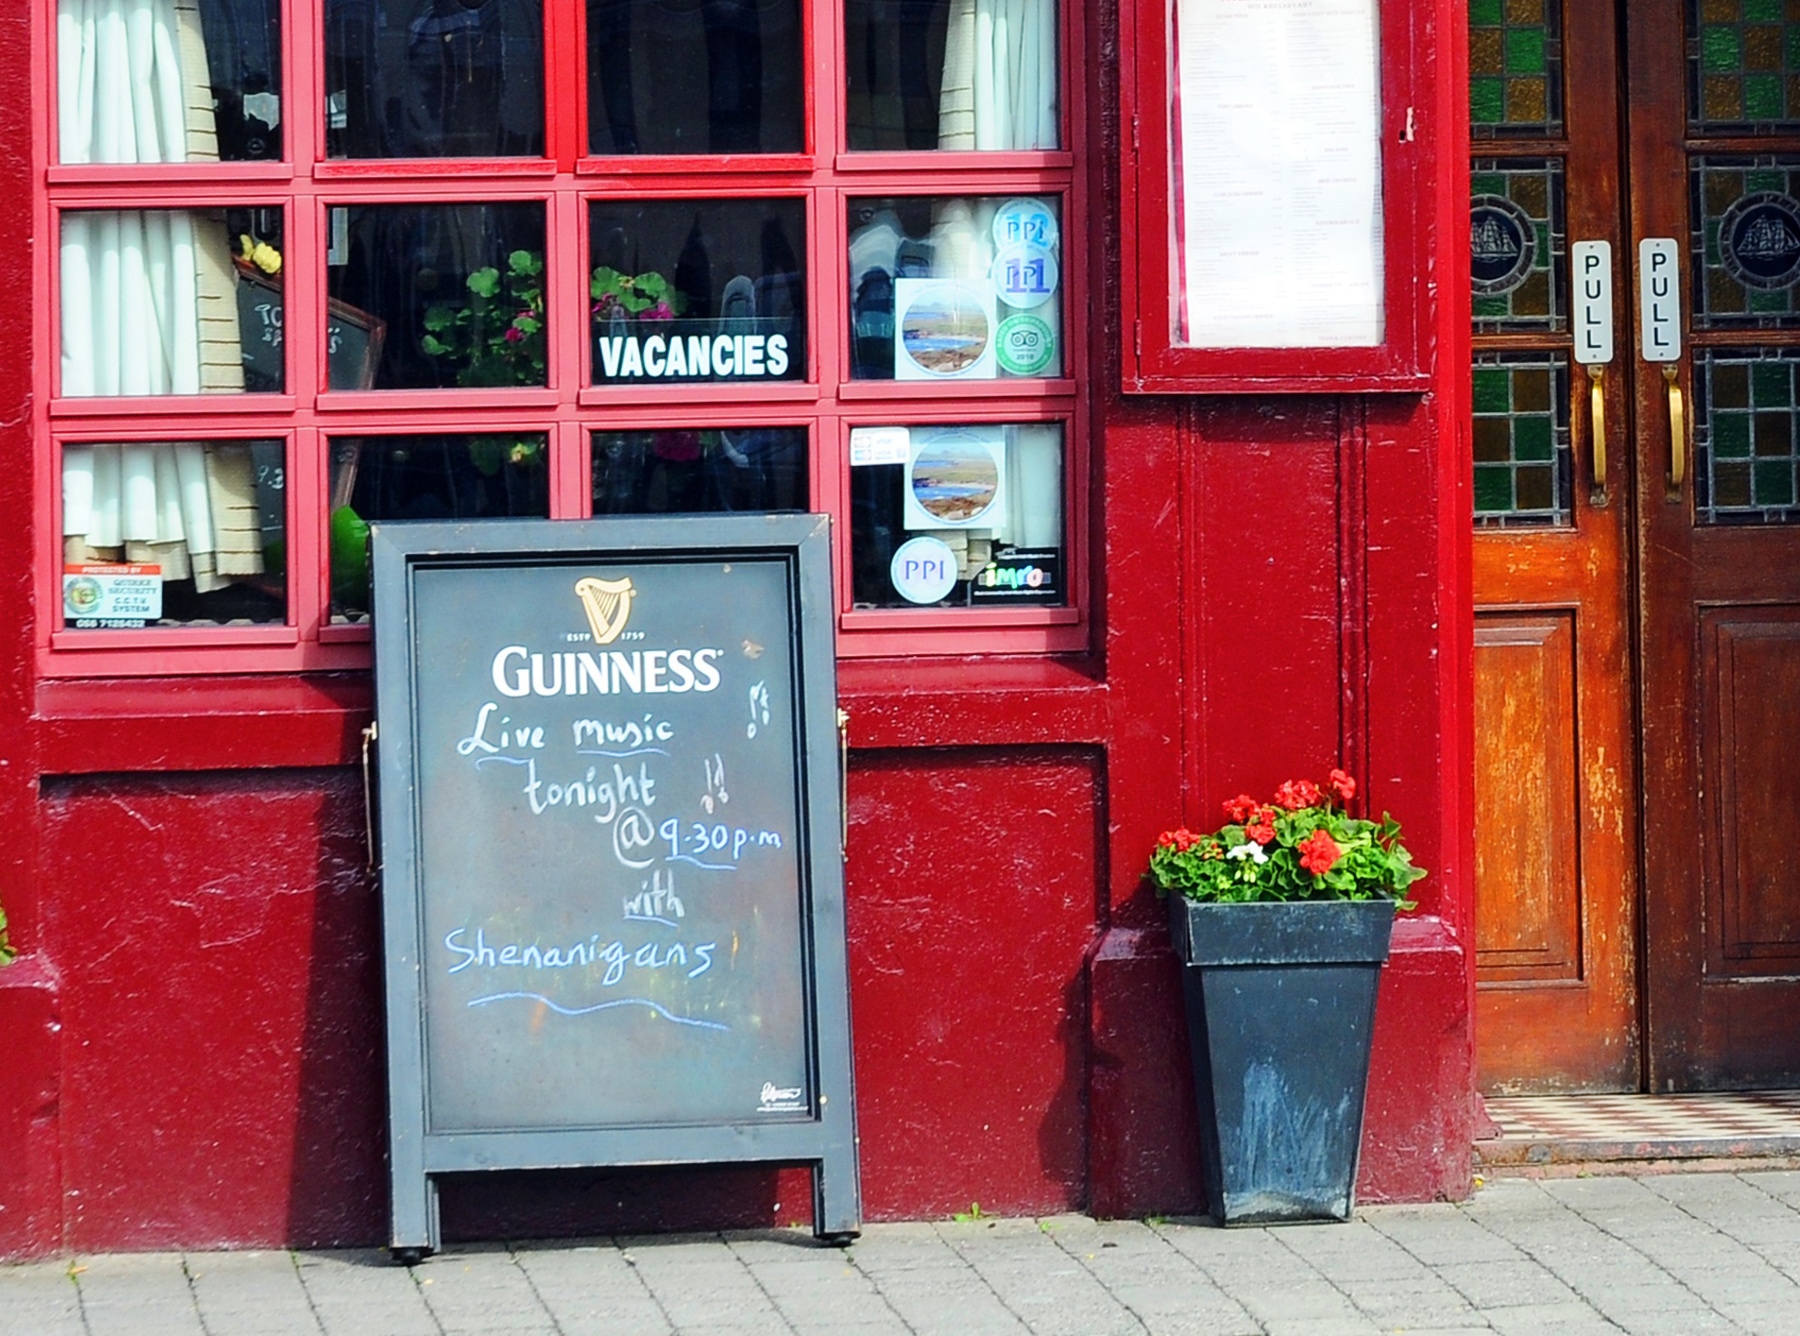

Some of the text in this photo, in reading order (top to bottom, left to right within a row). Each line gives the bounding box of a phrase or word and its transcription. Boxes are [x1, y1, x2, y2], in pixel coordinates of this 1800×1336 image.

[1585, 254, 1602, 349] PULL
[1650, 252, 1670, 347] PULL
[598, 333, 789, 378] VACANCIES
[904, 560, 944, 580] PPI
[491, 645, 722, 698] GUINNESS
[457, 702, 675, 755] Live music
[523, 758, 657, 824] tonight
[612, 806, 656, 869] @
[622, 869, 686, 918] with
[444, 926, 717, 987] Shenanigans
